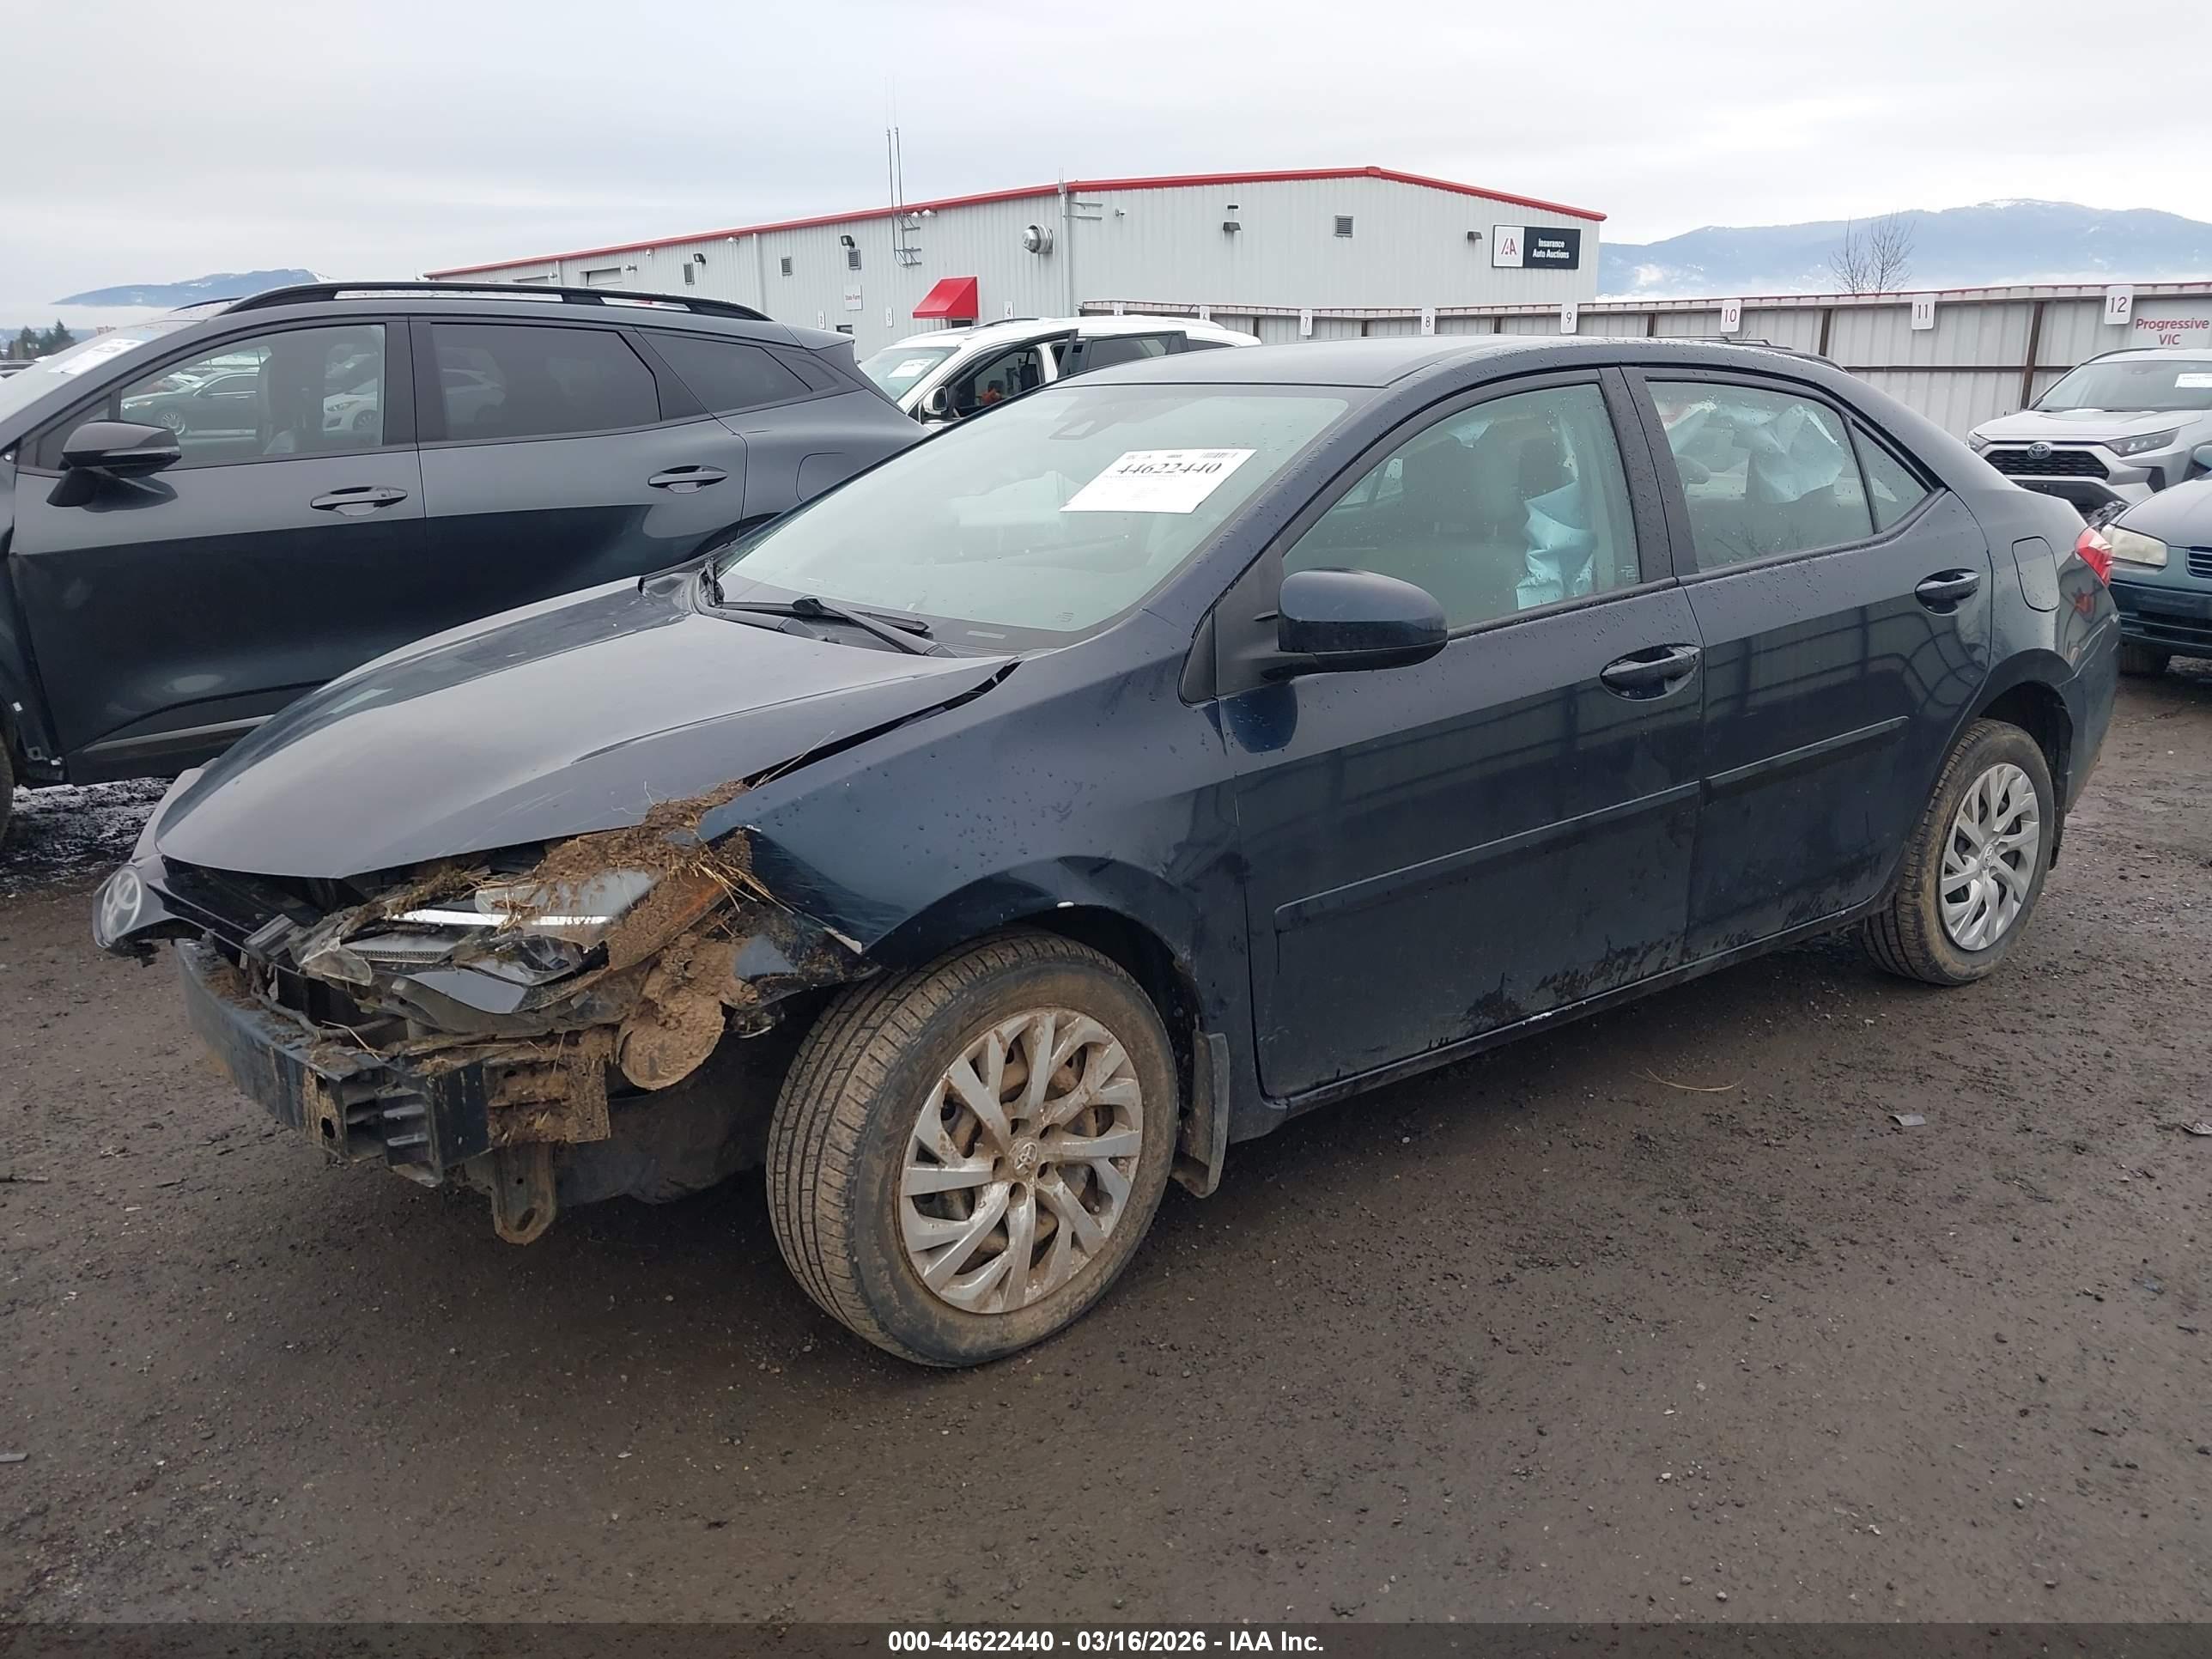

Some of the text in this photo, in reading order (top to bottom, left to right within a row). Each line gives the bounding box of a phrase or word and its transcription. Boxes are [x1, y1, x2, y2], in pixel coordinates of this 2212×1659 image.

[1538, 238, 1565, 249] Insurance
[1532, 248, 1570, 259] Auto Auctions
[2110, 296, 2128, 313] 12
[1566, 311, 1572, 324] 9
[1724, 308, 1737, 324] 10
[1917, 304, 1929, 319] 11
[1304, 316, 1310, 328] 7
[1425, 316, 1431, 328] 8
[2136, 317, 2210, 331] Progressive
[2159, 333, 2182, 345] VIC
[1116, 462, 1223, 474] 44622440
